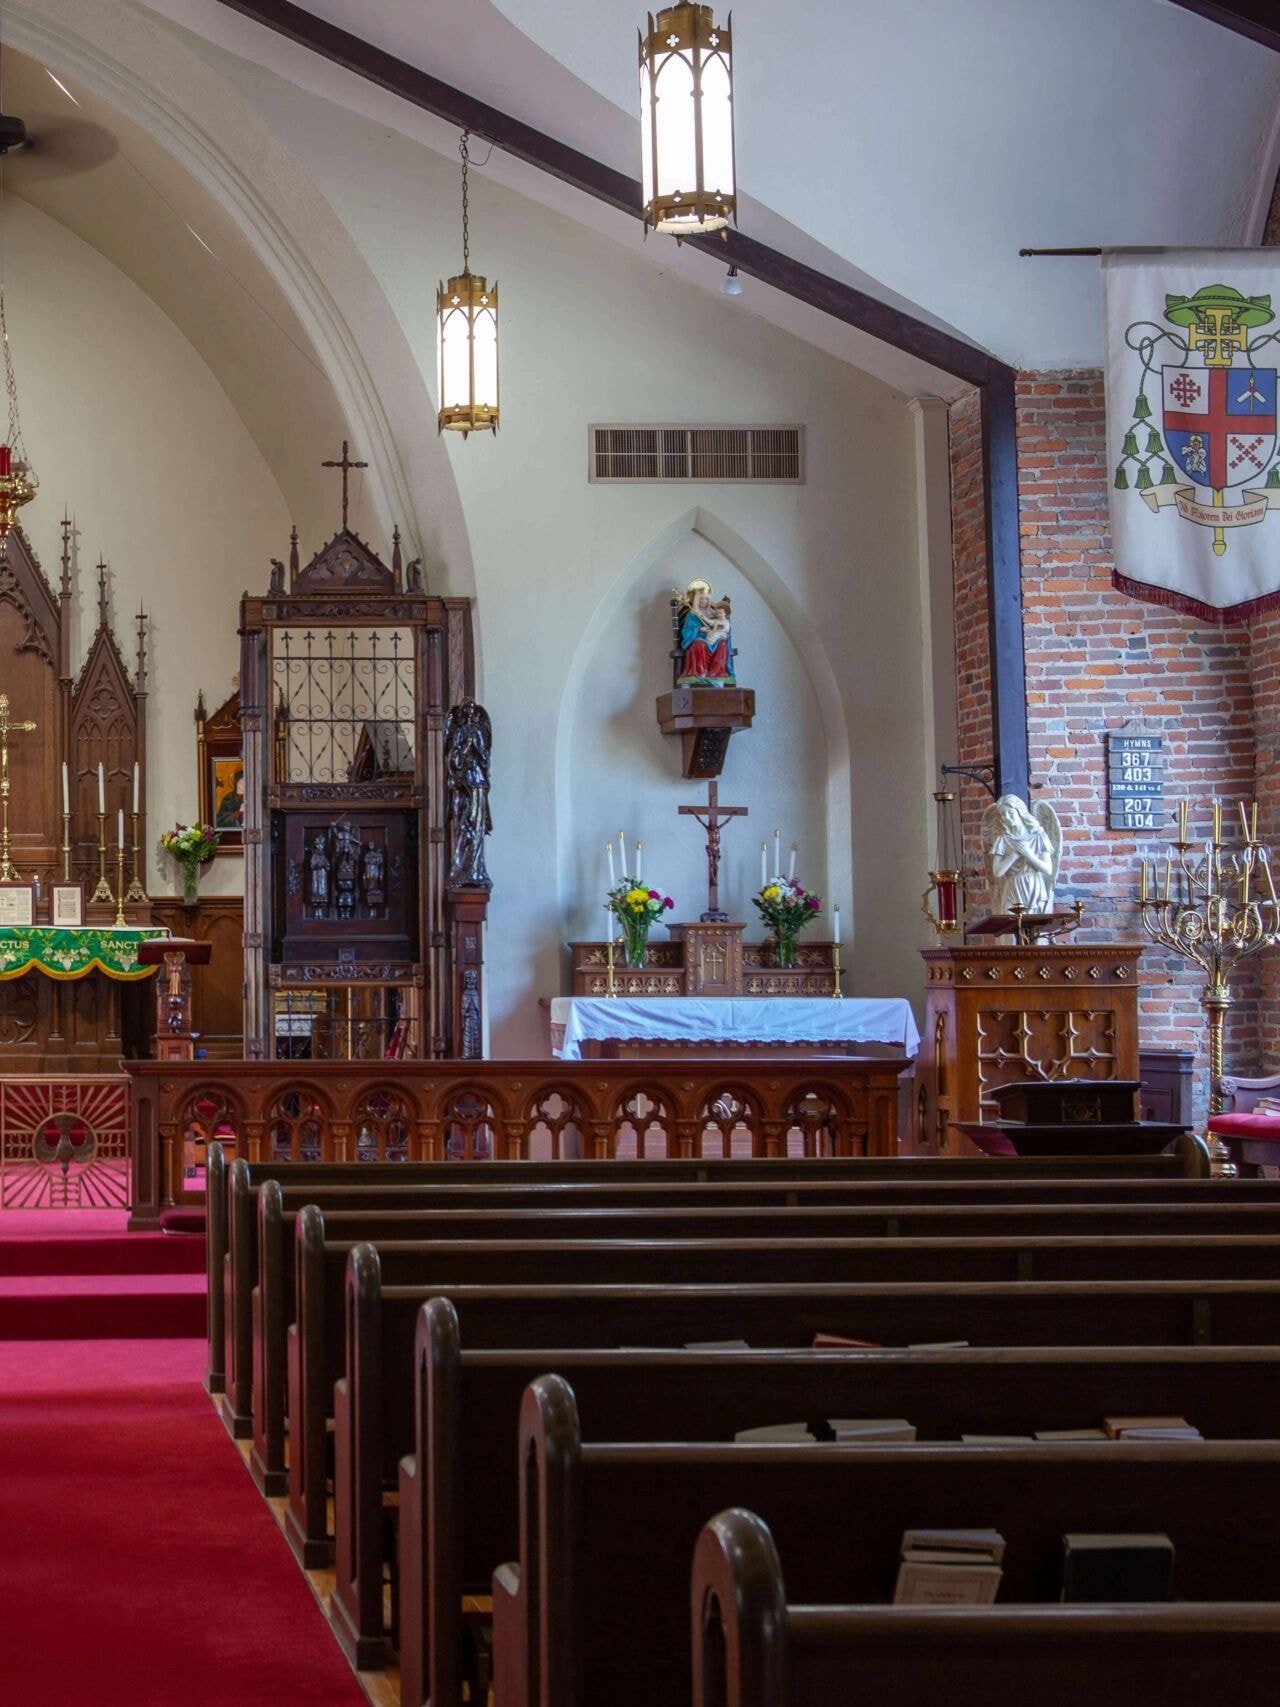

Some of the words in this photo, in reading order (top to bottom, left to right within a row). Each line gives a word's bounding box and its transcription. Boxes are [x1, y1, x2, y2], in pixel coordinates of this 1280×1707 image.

[1191, 506, 1220, 522] Majorem
[1222, 511, 1233, 522] Dei
[1235, 507, 1264, 520] Gloriam
[1124, 739, 1151, 748] HYMNS
[1122, 752, 1150, 766] 367
[1124, 768, 1151, 781] 403
[1124, 799, 1152, 812] 207
[1128, 814, 1154, 827] 104
[100, 940, 138, 949] SANCT
